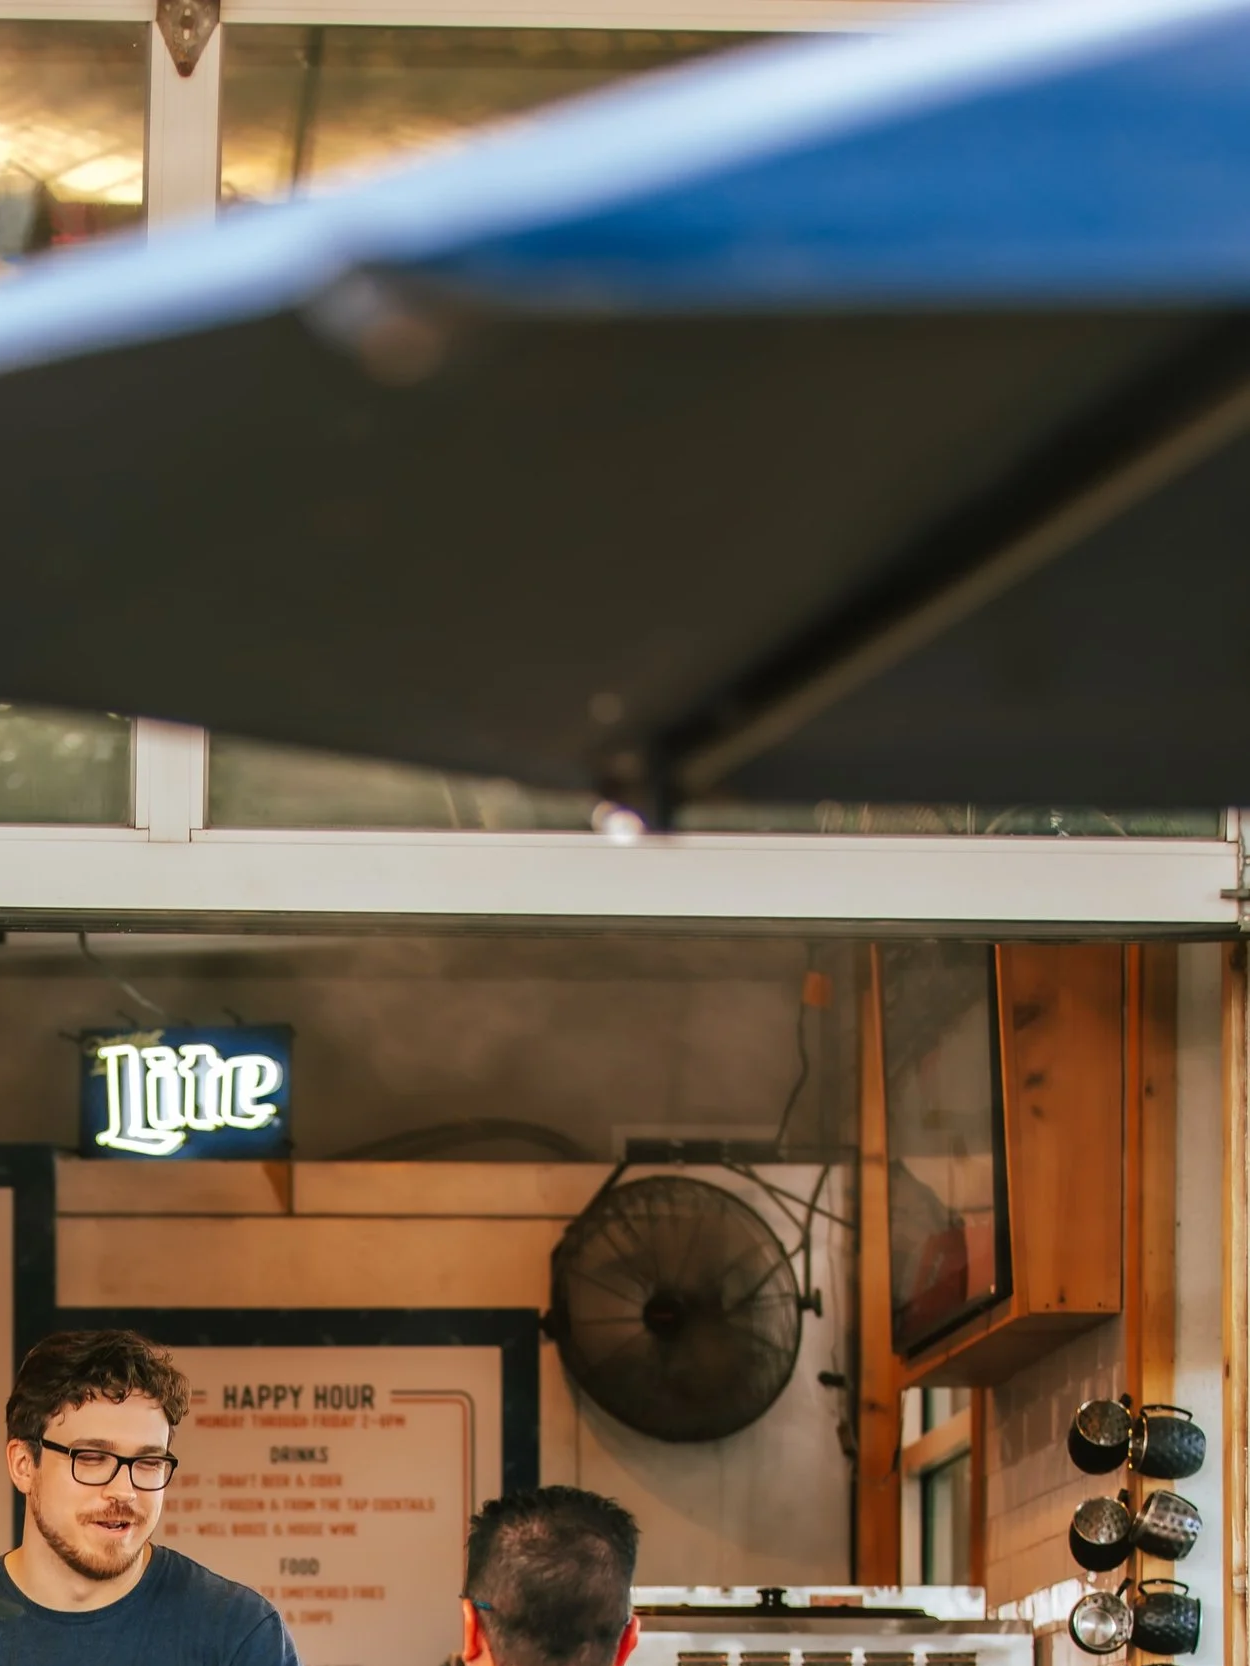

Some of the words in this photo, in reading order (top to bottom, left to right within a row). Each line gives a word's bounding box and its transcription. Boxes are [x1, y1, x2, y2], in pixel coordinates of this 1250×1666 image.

[96, 1043, 283, 1156] Lite
[223, 1384, 303, 1410] HAPPY
[313, 1384, 375, 1410] HOUR
[195, 1413, 245, 1428] MONDAY
[252, 1413, 309, 1428] THROUGH
[312, 1413, 356, 1428] FRIDAY
[269, 1446, 329, 1464] DRINKS
[279, 1557, 320, 1576] FOOD
